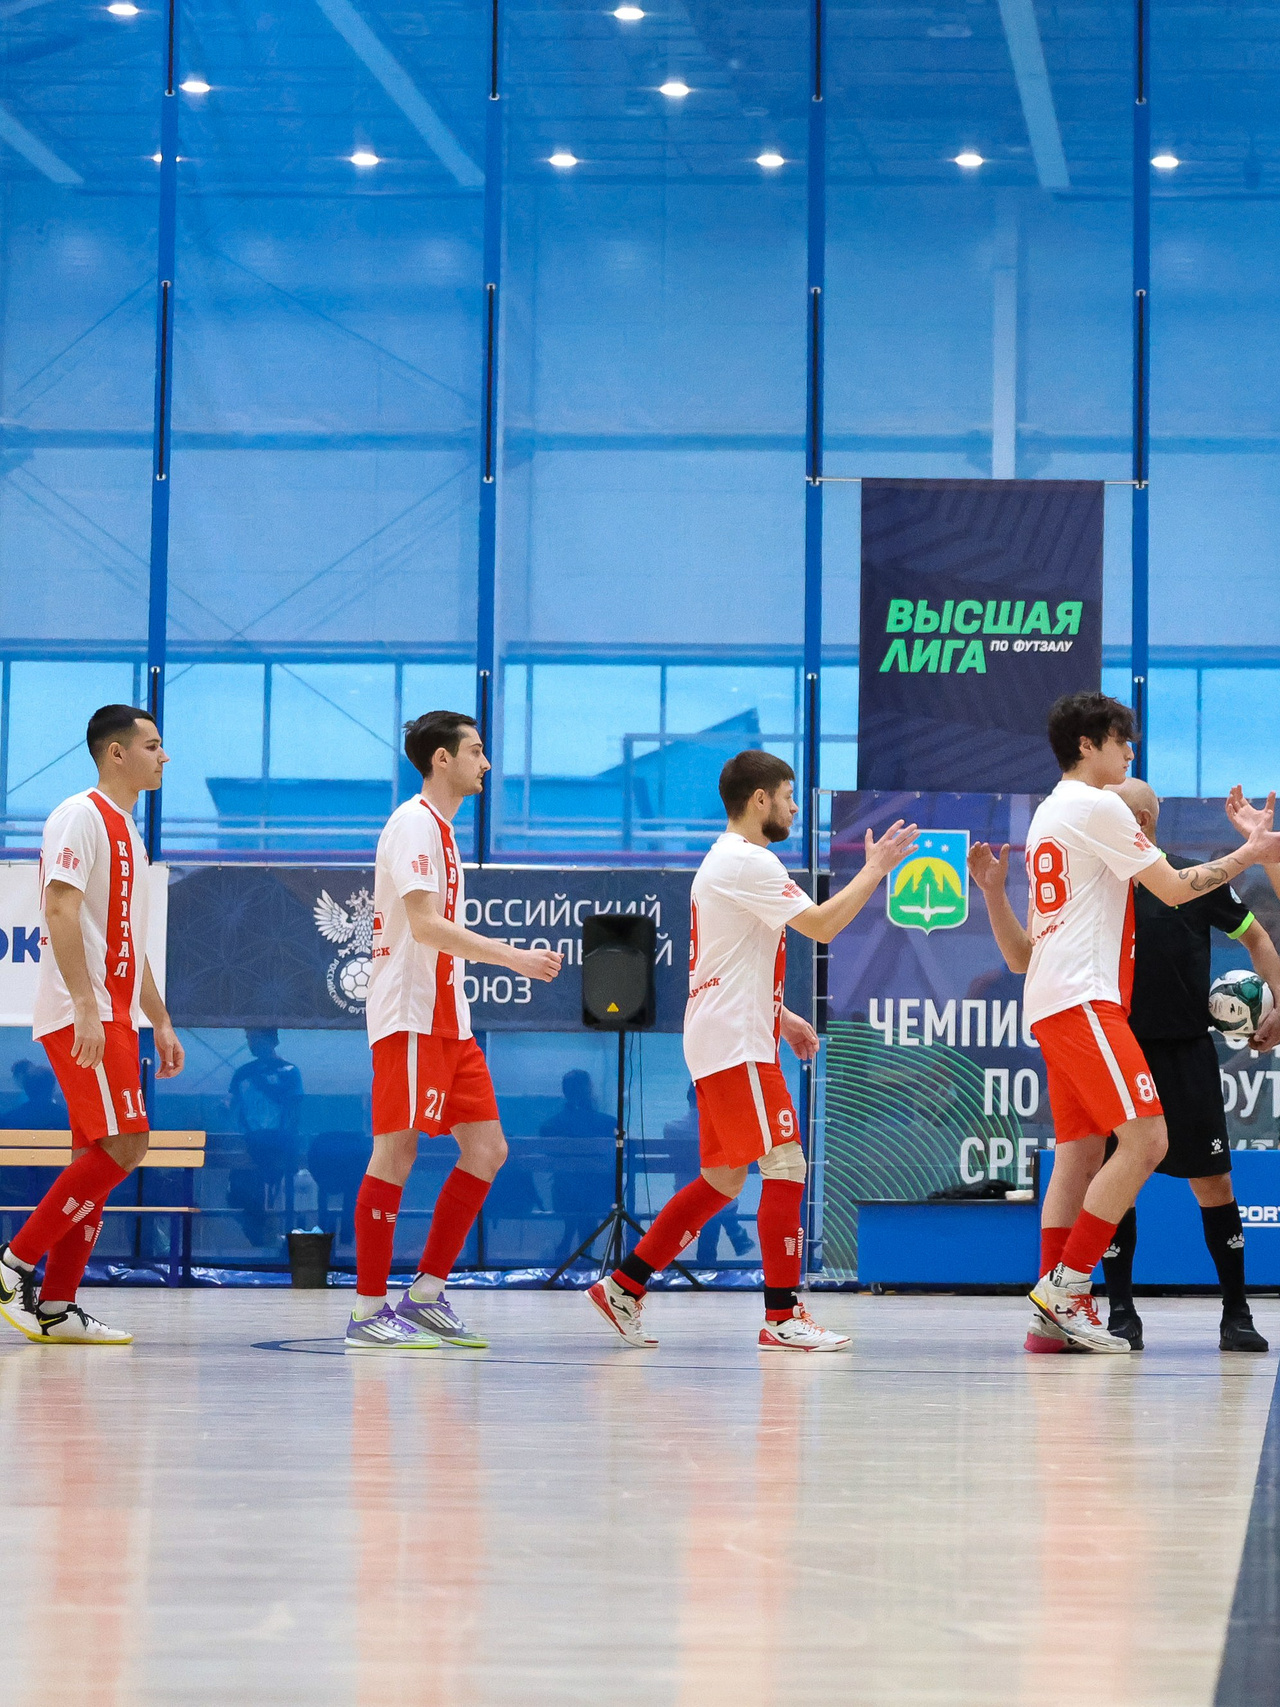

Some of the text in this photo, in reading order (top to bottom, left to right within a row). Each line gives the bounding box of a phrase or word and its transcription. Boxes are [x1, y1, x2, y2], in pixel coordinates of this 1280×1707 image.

[886, 598, 1083, 635] ВЫСШАЯ
[879, 638, 1074, 674] ЛИГА ПО ФУТЗАЛУ
[1025, 837, 1072, 918] 8
[114, 840, 130, 978] КВАРТАЛ
[464, 893, 661, 927] ОССИЙСКИЙ
[463, 976, 532, 1004] ОЮЗ
[869, 997, 1041, 1048] ЧЕМПИ
[424, 1086, 446, 1123] 21
[984, 1068, 1040, 1117] ПО
[1134, 1071, 1160, 1104] 8
[777, 1107, 795, 1138] 9
[960, 1136, 1056, 1185] СРЕ
